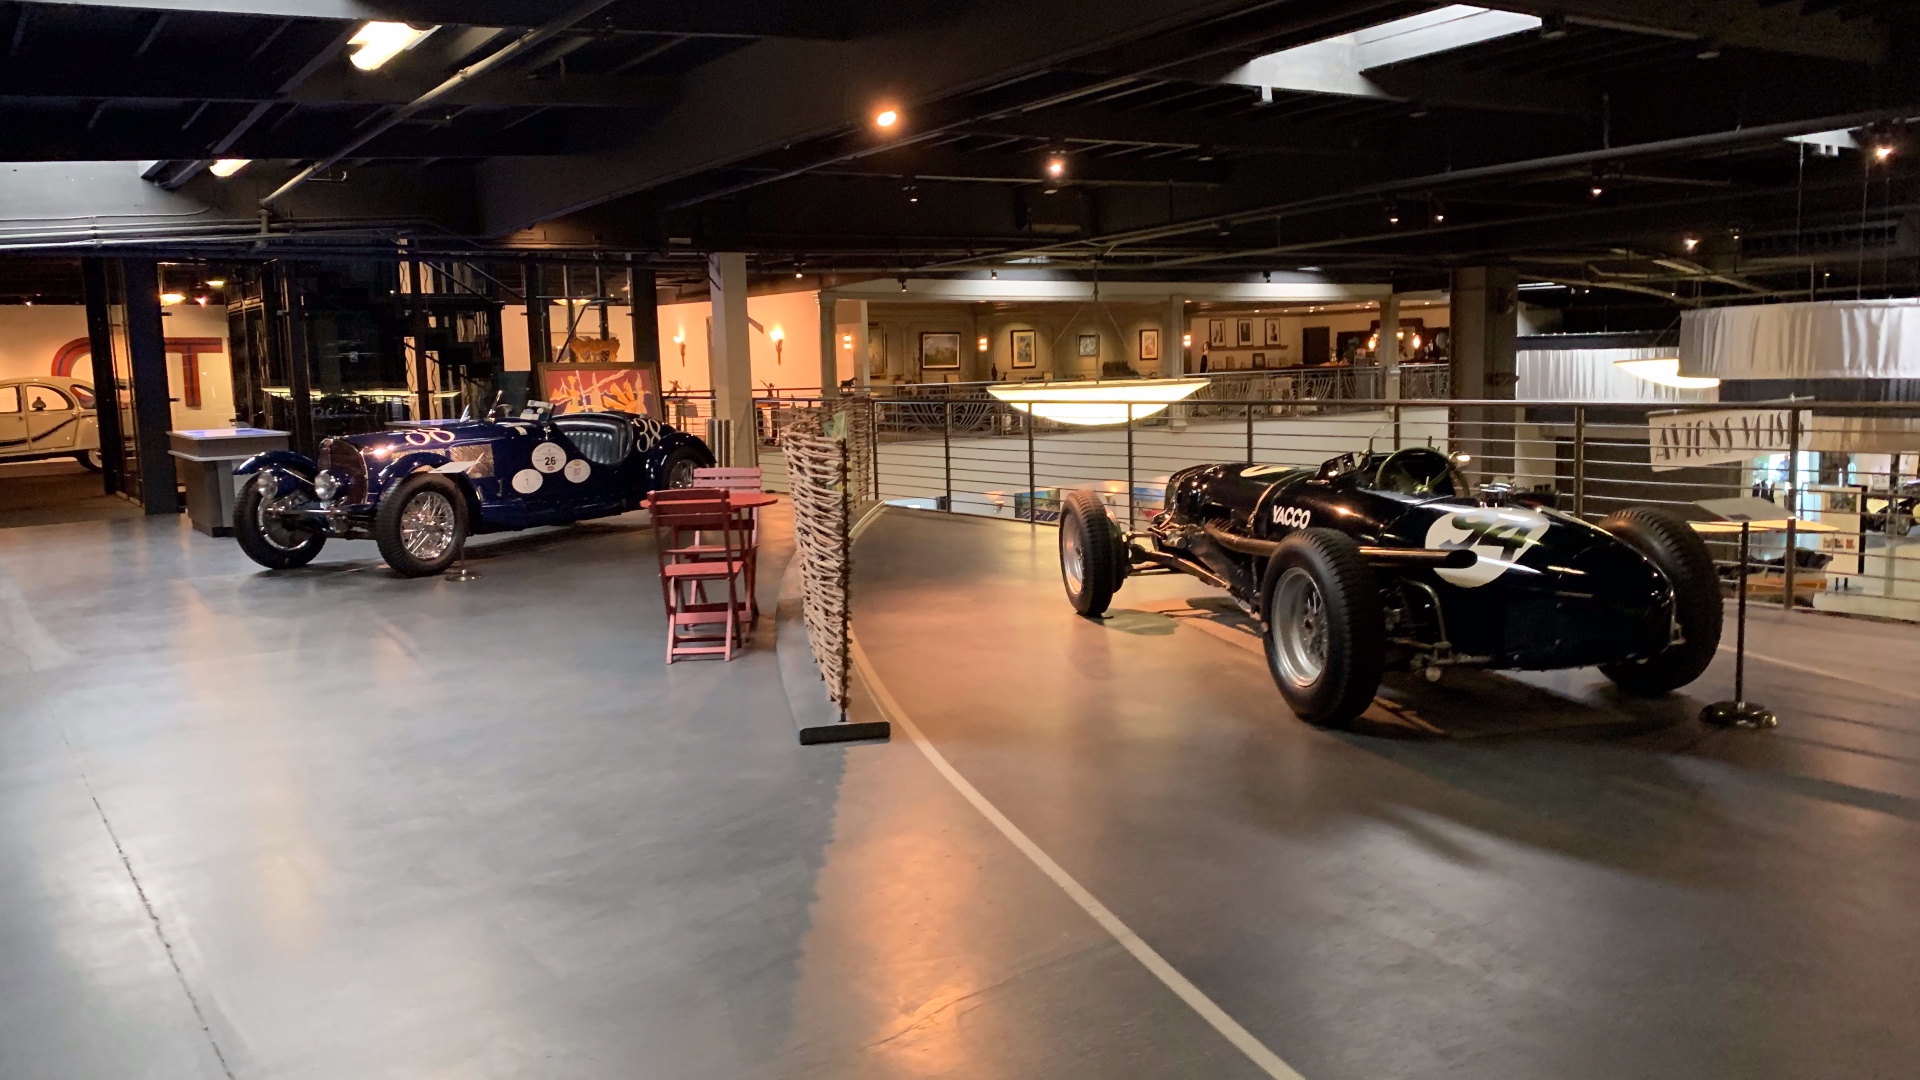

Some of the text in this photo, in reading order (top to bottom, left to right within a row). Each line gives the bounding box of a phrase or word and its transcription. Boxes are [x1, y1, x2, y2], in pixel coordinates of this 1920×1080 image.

[633, 418, 662, 453] 38
[1654, 416, 1734, 462] AVIONS
[544, 456, 557, 466] 26
[1272, 504, 1311, 530] YACCO
